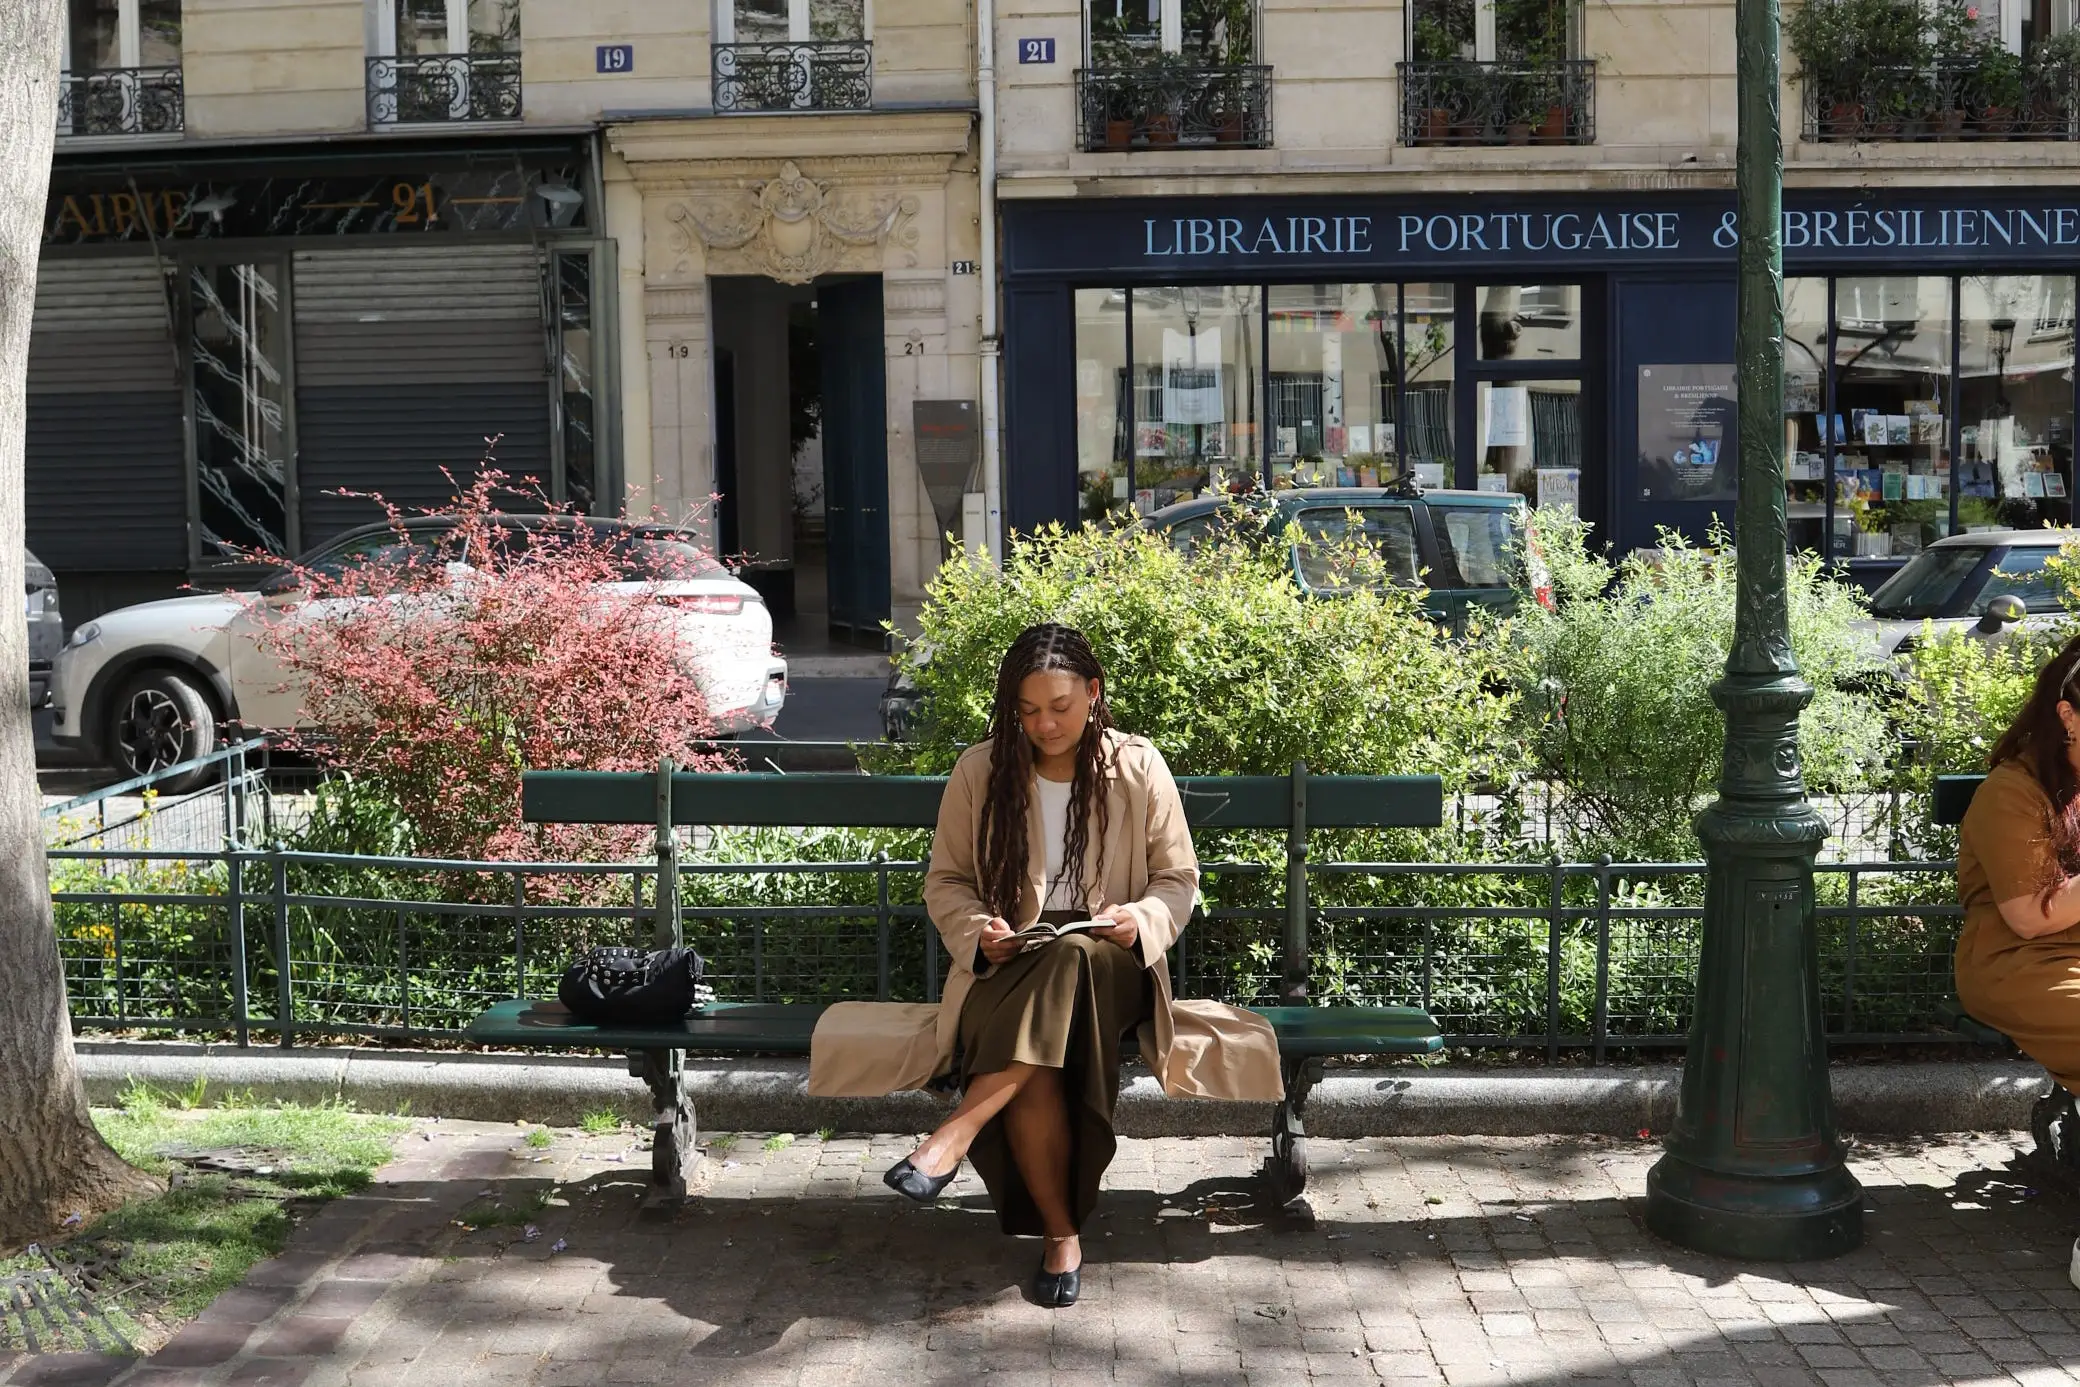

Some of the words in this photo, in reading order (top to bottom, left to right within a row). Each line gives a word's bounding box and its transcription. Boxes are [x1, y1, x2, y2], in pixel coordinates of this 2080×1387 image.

[604, 48, 625, 69] 19
[1026, 40, 1048, 61] 21
[48, 190, 194, 237] AIRIE
[392, 182, 438, 223] 21
[1143, 216, 1373, 256] LIBRAIRIE
[1398, 211, 1681, 252] PORTUGAISE
[1712, 211, 1738, 249] &
[1782, 202, 2080, 248] BRÉSILIENNE
[955, 262, 971, 273] 21
[668, 345, 689, 359] 19
[904, 342, 924, 355] 21
